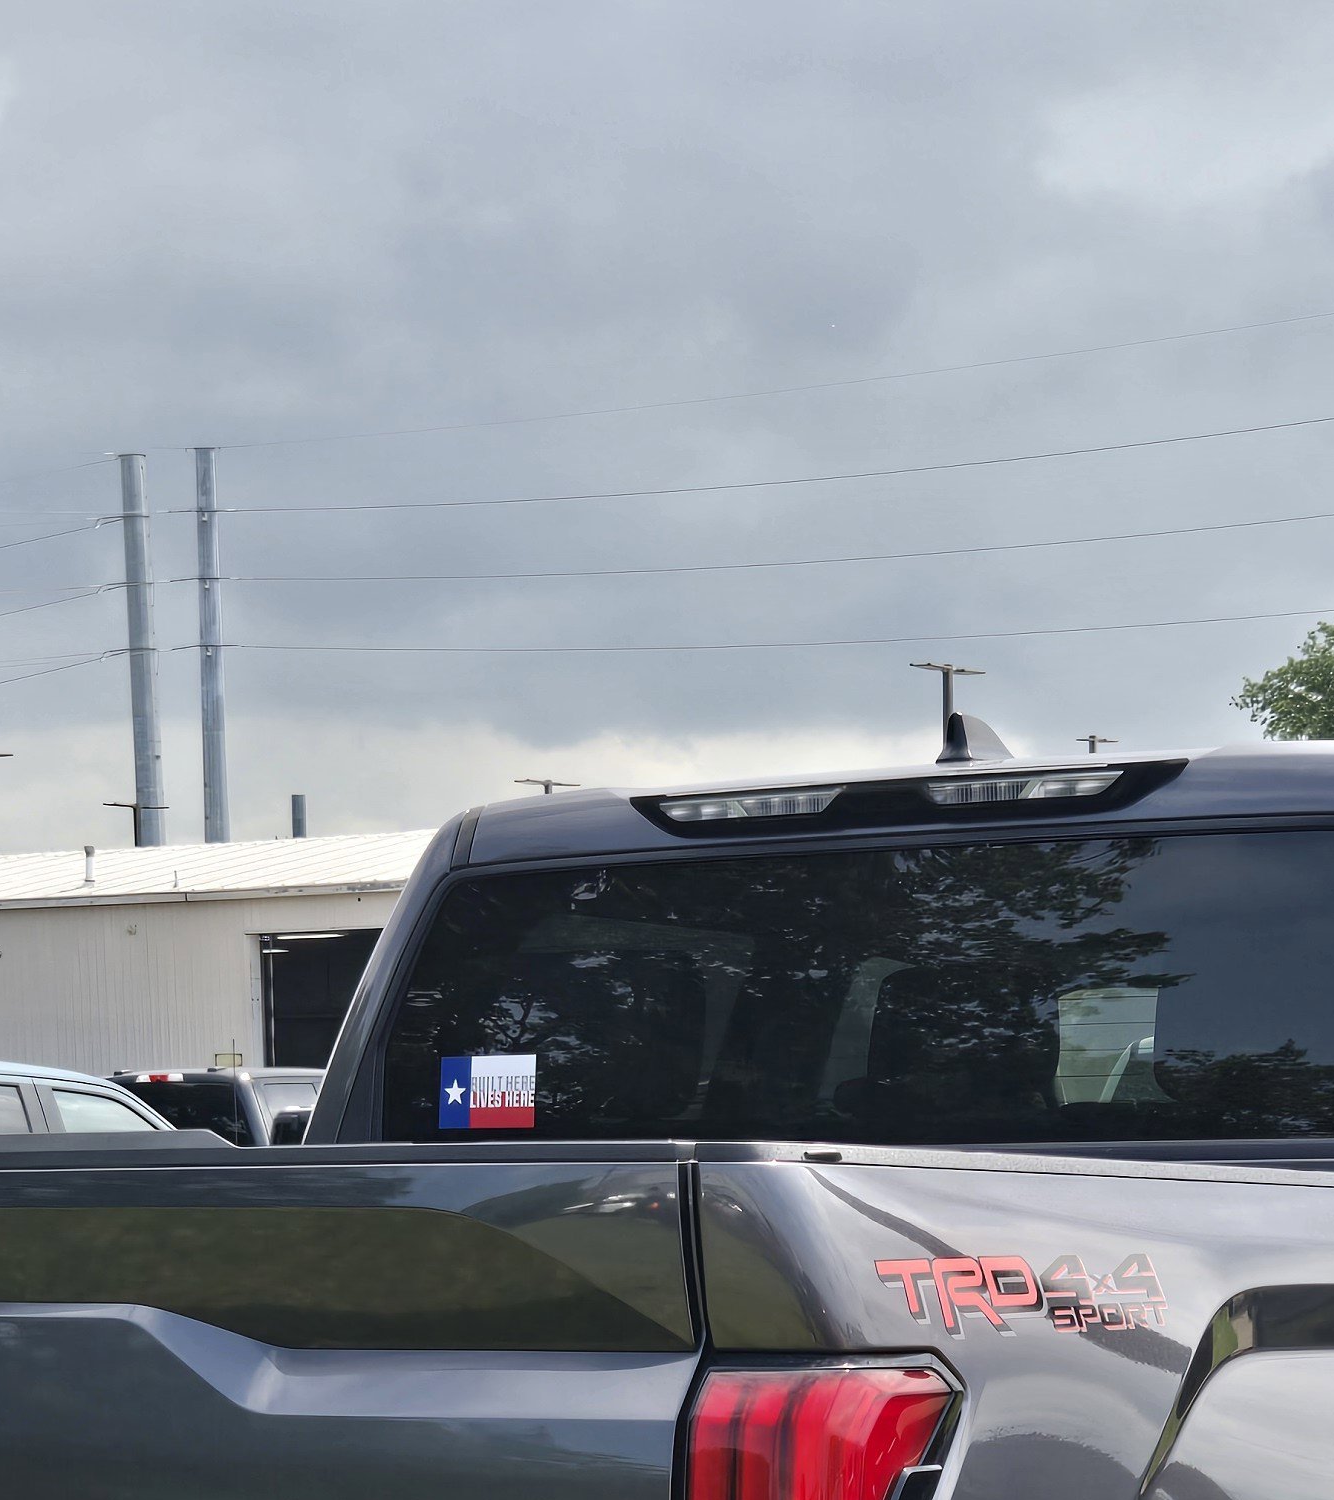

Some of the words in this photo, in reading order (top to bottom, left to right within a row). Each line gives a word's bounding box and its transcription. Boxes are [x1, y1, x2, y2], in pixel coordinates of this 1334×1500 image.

[471, 1075, 503, 1093] BUILT
[505, 1075, 536, 1092] HERE
[470, 1090, 502, 1109] LIVES
[505, 1090, 535, 1108] HERE
[874, 1254, 1048, 1340] TRD
[1051, 1300, 1169, 1334] SPORT
